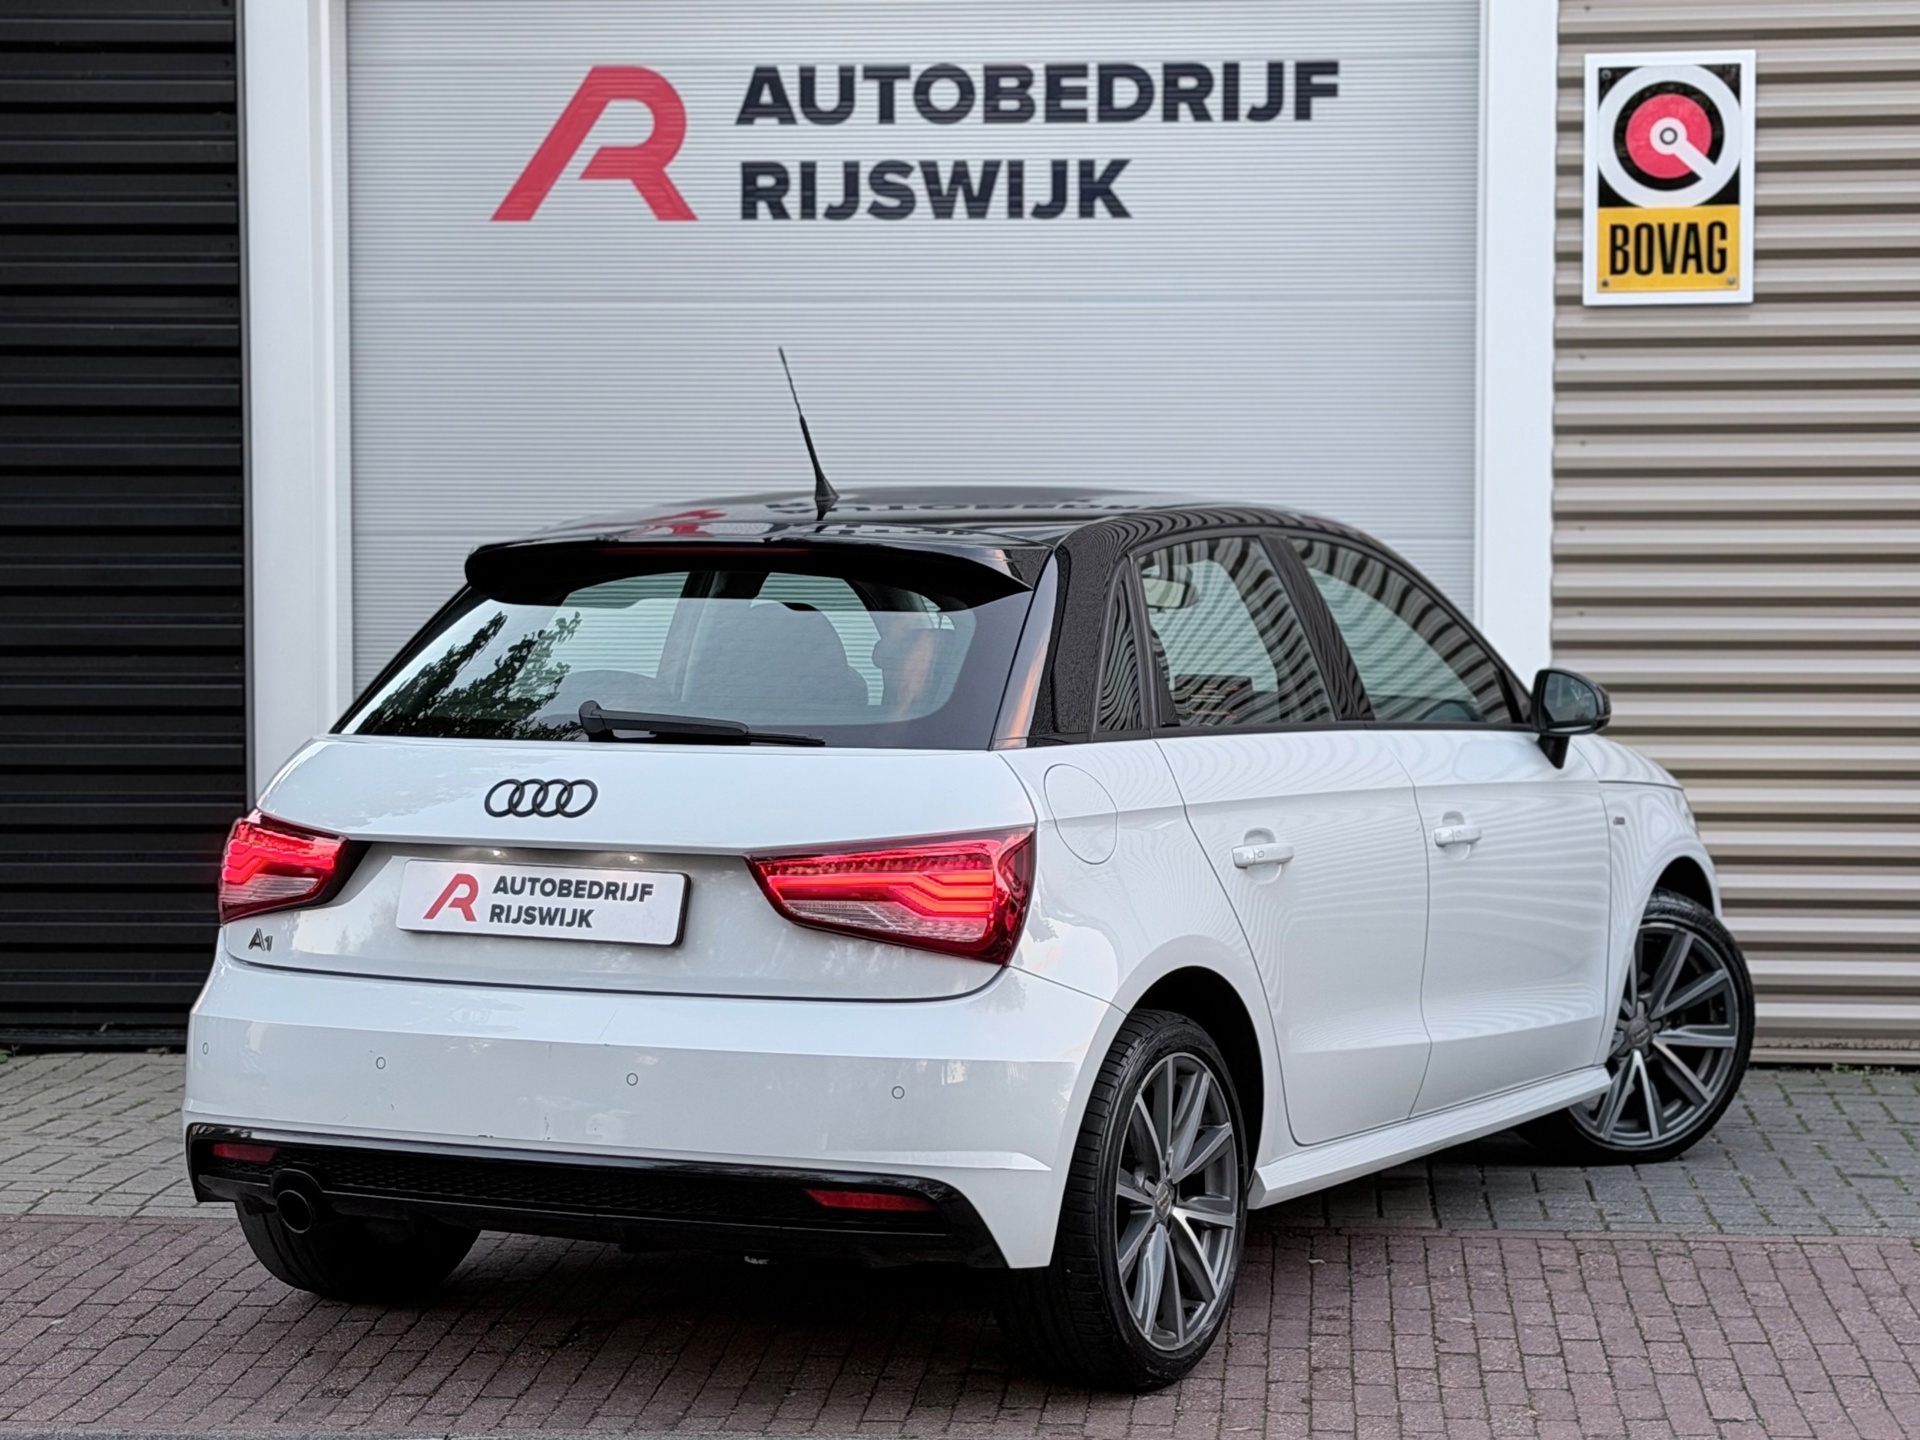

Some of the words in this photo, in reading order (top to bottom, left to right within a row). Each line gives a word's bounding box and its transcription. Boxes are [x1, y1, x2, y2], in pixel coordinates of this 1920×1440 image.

[735, 60, 1340, 126] AUTOBEDRIJF
[740, 159, 1132, 221] RIJSWIJK
[1609, 220, 1728, 276] BOVAG
[492, 875, 654, 902] AUTOBEDRIJF
[489, 904, 595, 928] RIJSWIJK
[248, 927, 273, 952] A1
